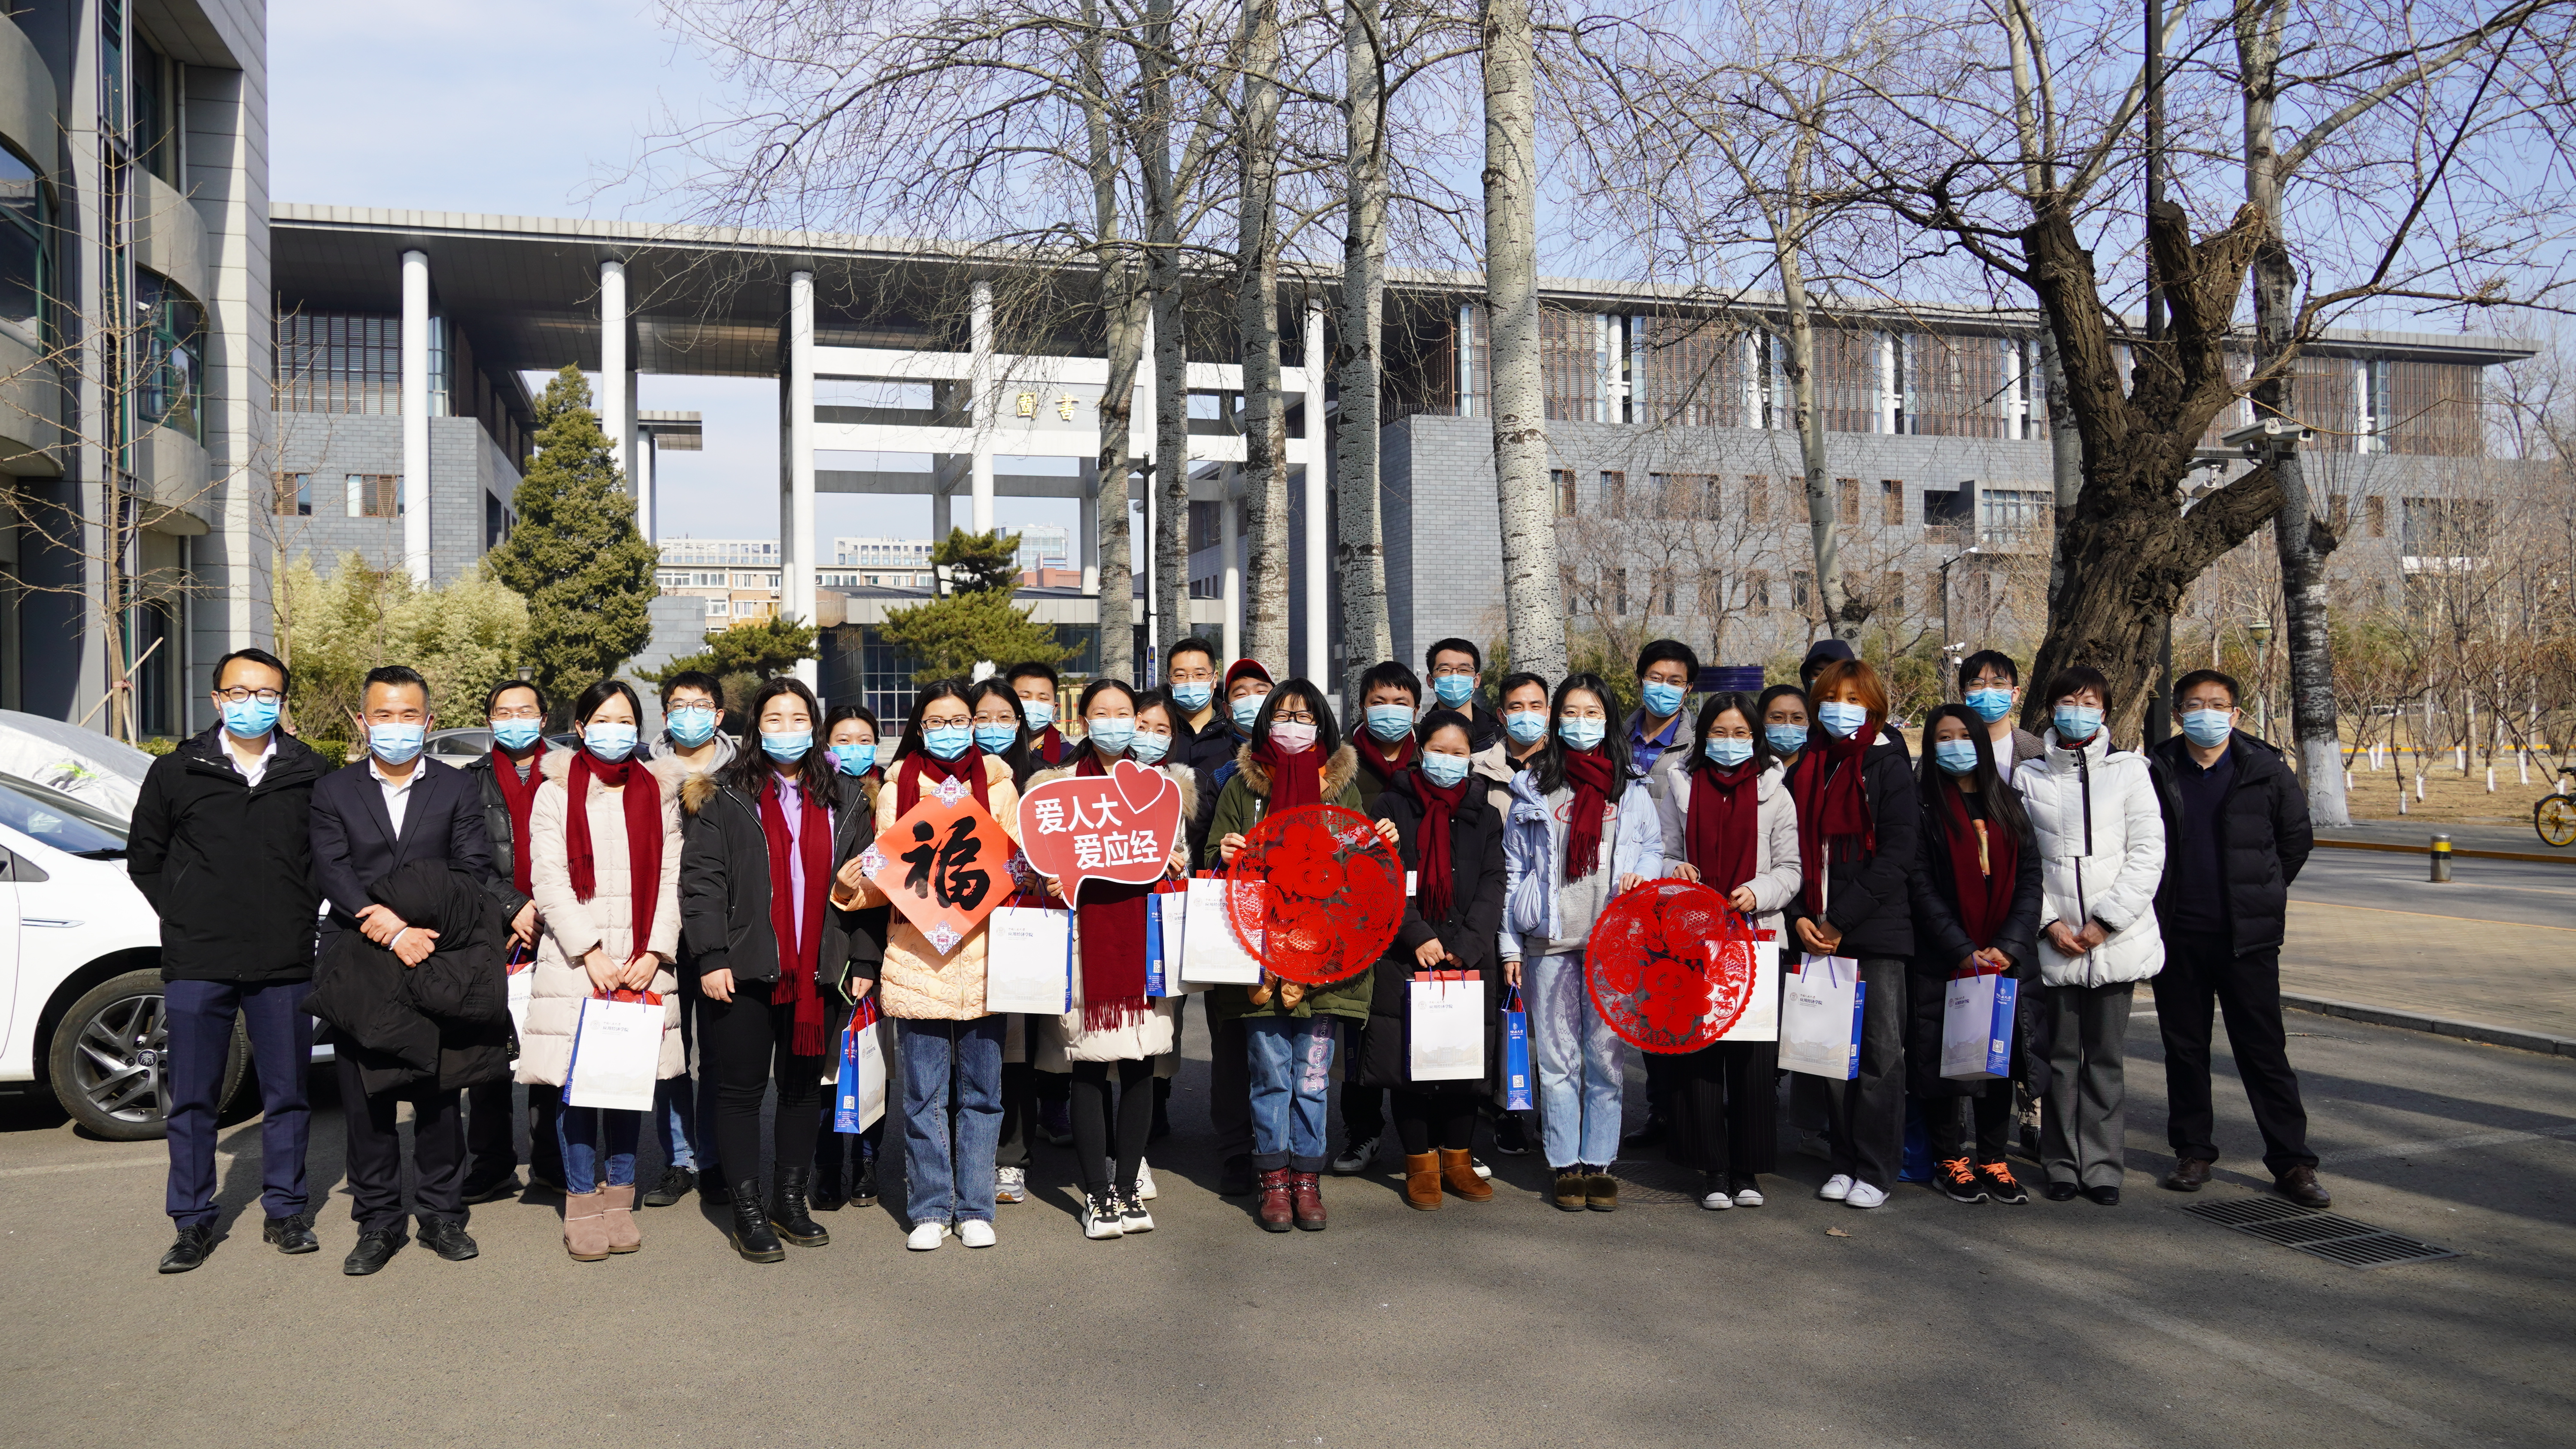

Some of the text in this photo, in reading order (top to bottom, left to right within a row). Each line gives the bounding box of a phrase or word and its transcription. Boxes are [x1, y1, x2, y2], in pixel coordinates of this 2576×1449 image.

[1035, 793, 1122, 835] 爱人大
[901, 816, 990, 911] 福
[1073, 829, 1161, 870] 爱应经
[140, 1052, 154, 1065] 秦
